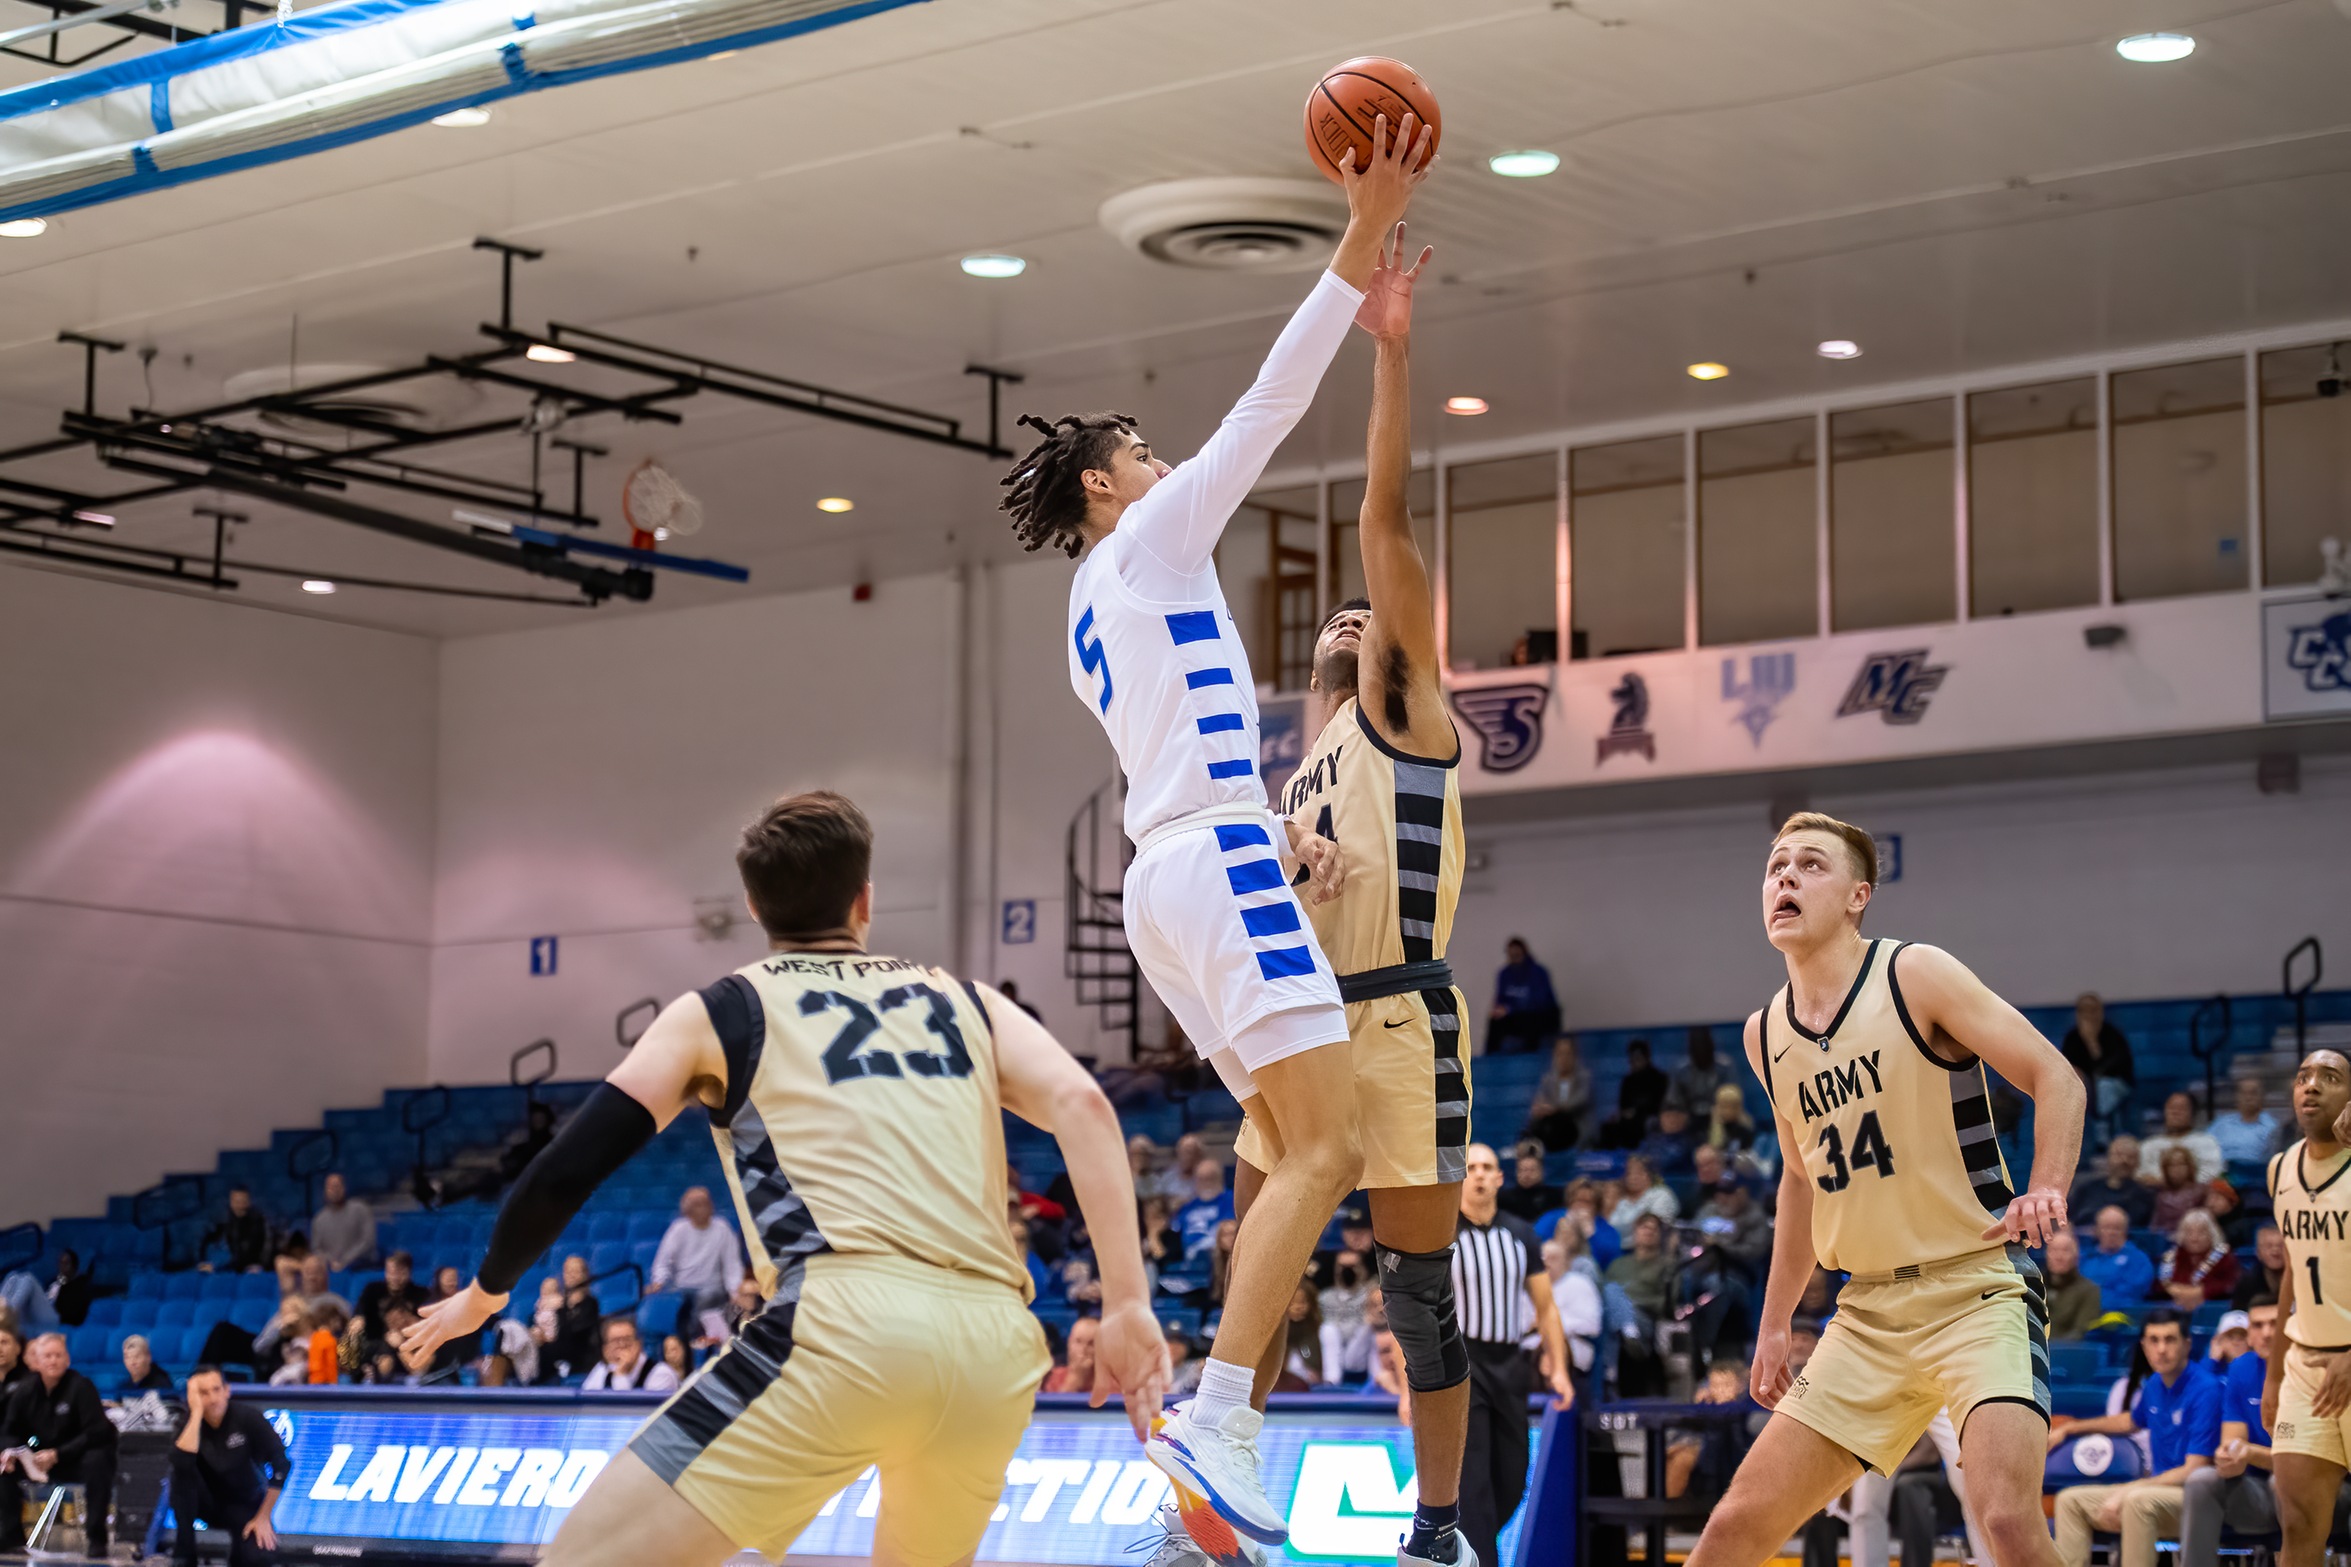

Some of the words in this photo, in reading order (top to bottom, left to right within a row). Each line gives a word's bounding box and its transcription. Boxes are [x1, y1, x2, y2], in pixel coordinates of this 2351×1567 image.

[1074, 600, 1114, 719] 5
[1008, 906, 1030, 938] 2
[537, 940, 551, 973] 1
[762, 959, 845, 981] WEST
[797, 982, 974, 1085] 23
[1798, 1049, 1883, 1124] ARMY
[1816, 1109, 1896, 1194] 34
[2282, 1209, 2350, 1240] ARMY
[2306, 1256, 2323, 1305] 1
